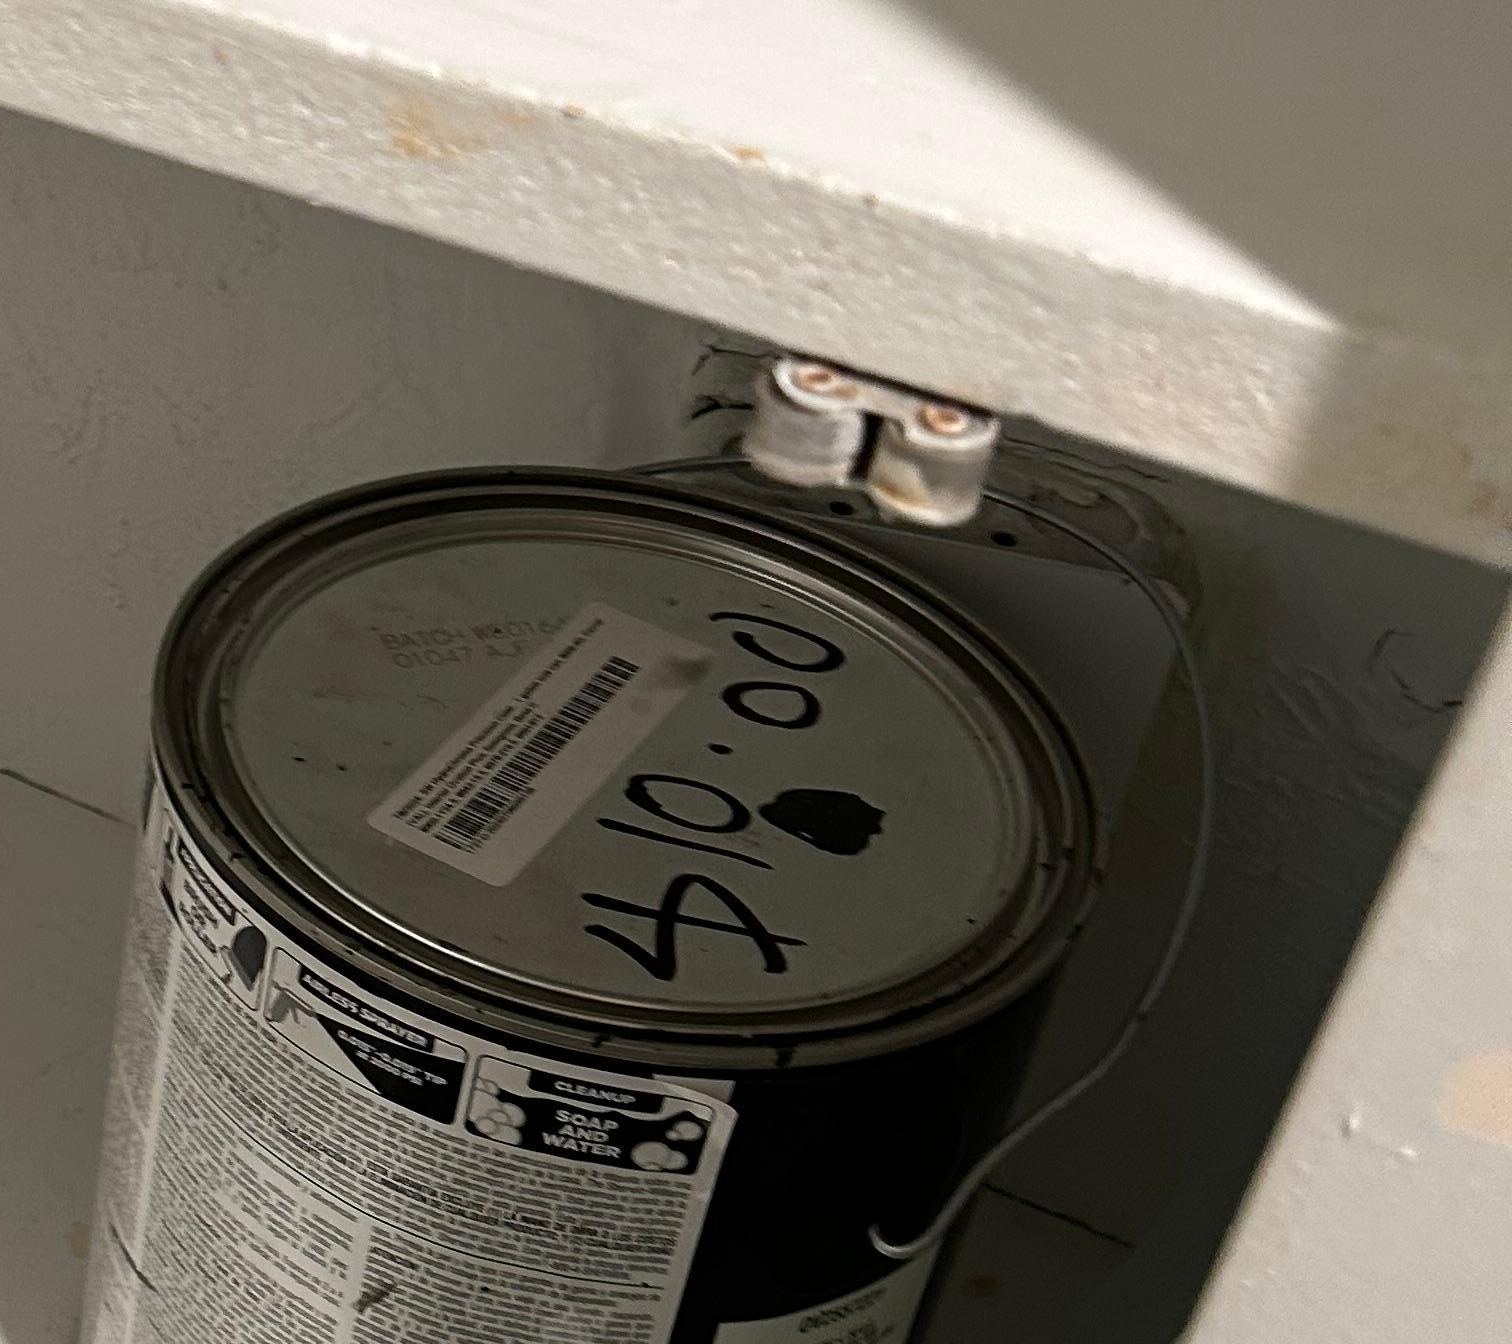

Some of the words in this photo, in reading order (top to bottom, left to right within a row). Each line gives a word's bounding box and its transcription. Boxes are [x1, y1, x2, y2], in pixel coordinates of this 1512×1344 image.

[581, 612, 846, 981] $10.00
[554, 1080, 636, 1104] CLEANUP
[555, 1109, 619, 1131] SOAP
[541, 1132, 622, 1159] WATER
[558, 1124, 609, 1143] AND
